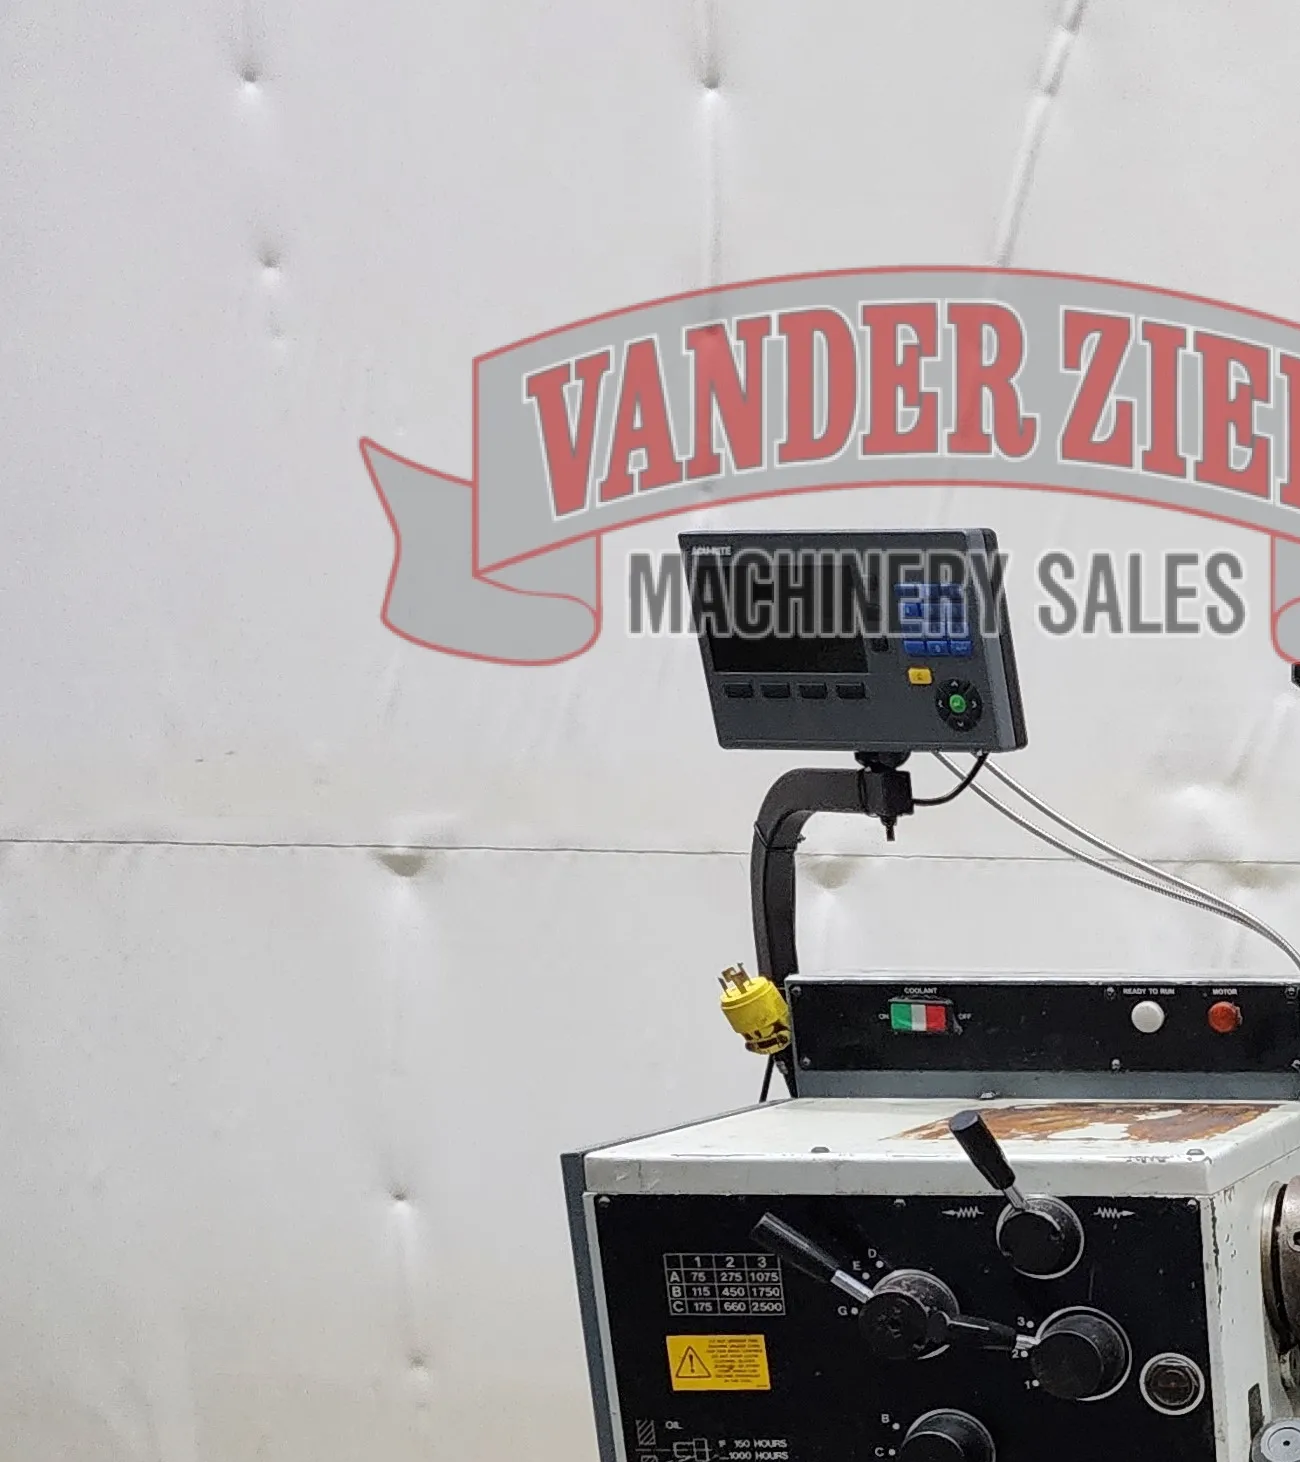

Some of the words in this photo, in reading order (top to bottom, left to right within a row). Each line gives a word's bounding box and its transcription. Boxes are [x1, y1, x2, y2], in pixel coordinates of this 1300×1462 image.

[1123, 987, 1146, 995] READY
[1148, 987, 1158, 995] TO
[868, 1248, 877, 1259] D
[694, 1256, 701, 1268] 1
[725, 1256, 735, 1268] 2
[757, 1256, 767, 1268] 3
[852, 1260, 862, 1271] E
[670, 1271, 680, 1282] A
[691, 1271, 706, 1282] 75
[720, 1271, 743, 1282] 275
[750, 1271, 779, 1281] 1075
[671, 1286, 682, 1297] B
[692, 1286, 711, 1296] 115
[721, 1287, 745, 1297] 450
[752, 1287, 780, 1297] 1750
[672, 1301, 684, 1312] C
[693, 1302, 713, 1312] 175
[723, 1302, 746, 1312] 660
[751, 1302, 782, 1312] 2500
[837, 1306, 848, 1316] G
[1017, 1316, 1025, 1327] 3
[1012, 1349, 1019, 1359] 2
[1024, 1380, 1031, 1390] 1
[881, 1414, 890, 1424] B
[665, 1420, 683, 1429] OIL
[753, 1439, 788, 1449] HOURS
[729, 1451, 752, 1460] 1000
[755, 1451, 789, 1460] HOURS
[874, 1447, 885, 1457] C
